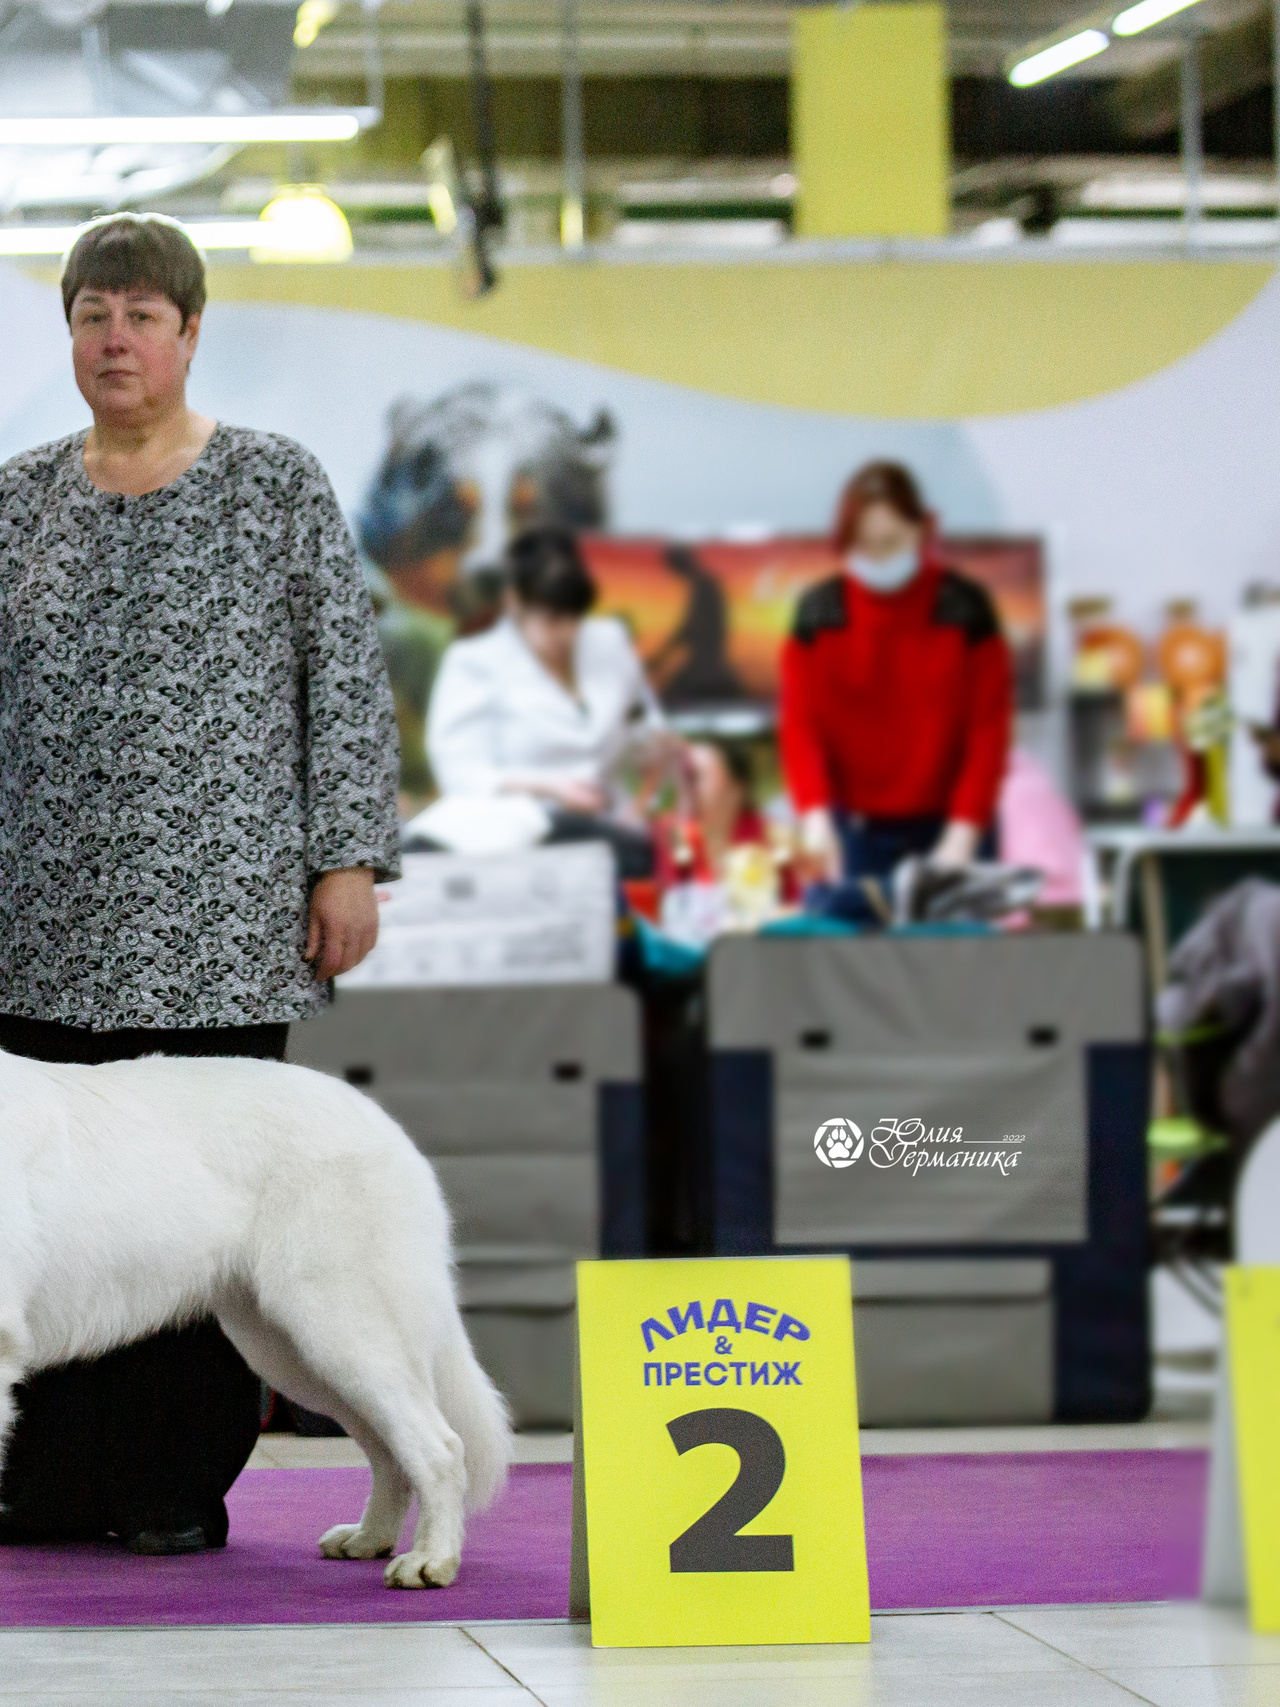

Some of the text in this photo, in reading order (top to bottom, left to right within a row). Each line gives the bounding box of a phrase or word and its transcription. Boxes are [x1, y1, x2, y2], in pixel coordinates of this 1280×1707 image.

[640, 1298, 811, 1353] ЛИДЕР
[714, 1335, 733, 1355] &
[643, 1361, 803, 1386] ПРЕСТИЖ
[666, 1408, 795, 1573] 2
